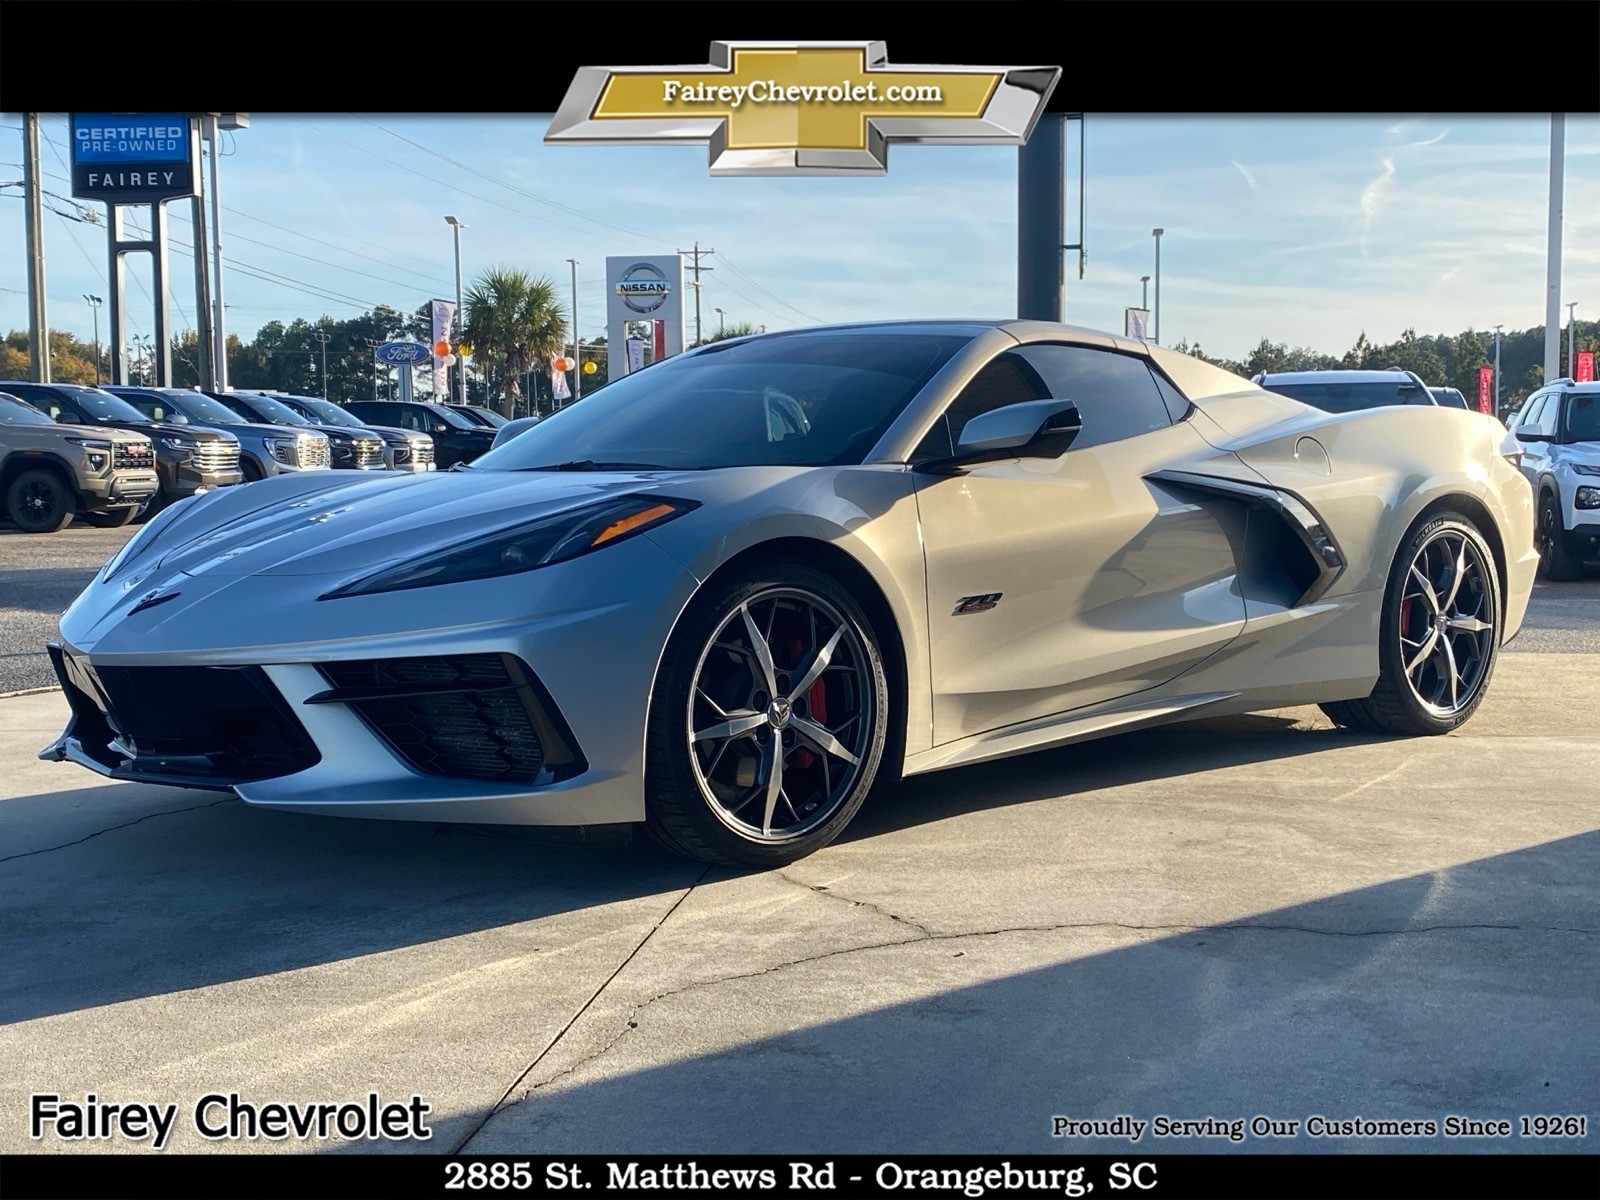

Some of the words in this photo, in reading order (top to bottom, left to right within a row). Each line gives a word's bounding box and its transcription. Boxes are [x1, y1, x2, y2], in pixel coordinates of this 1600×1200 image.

[76, 127, 182, 140] CERTIFIED
[82, 140, 176, 152] PRE-OWNED
[88, 172, 174, 187] FAIREY
[620, 283, 666, 292] NISSAN
[387, 345, 419, 361] Ford
